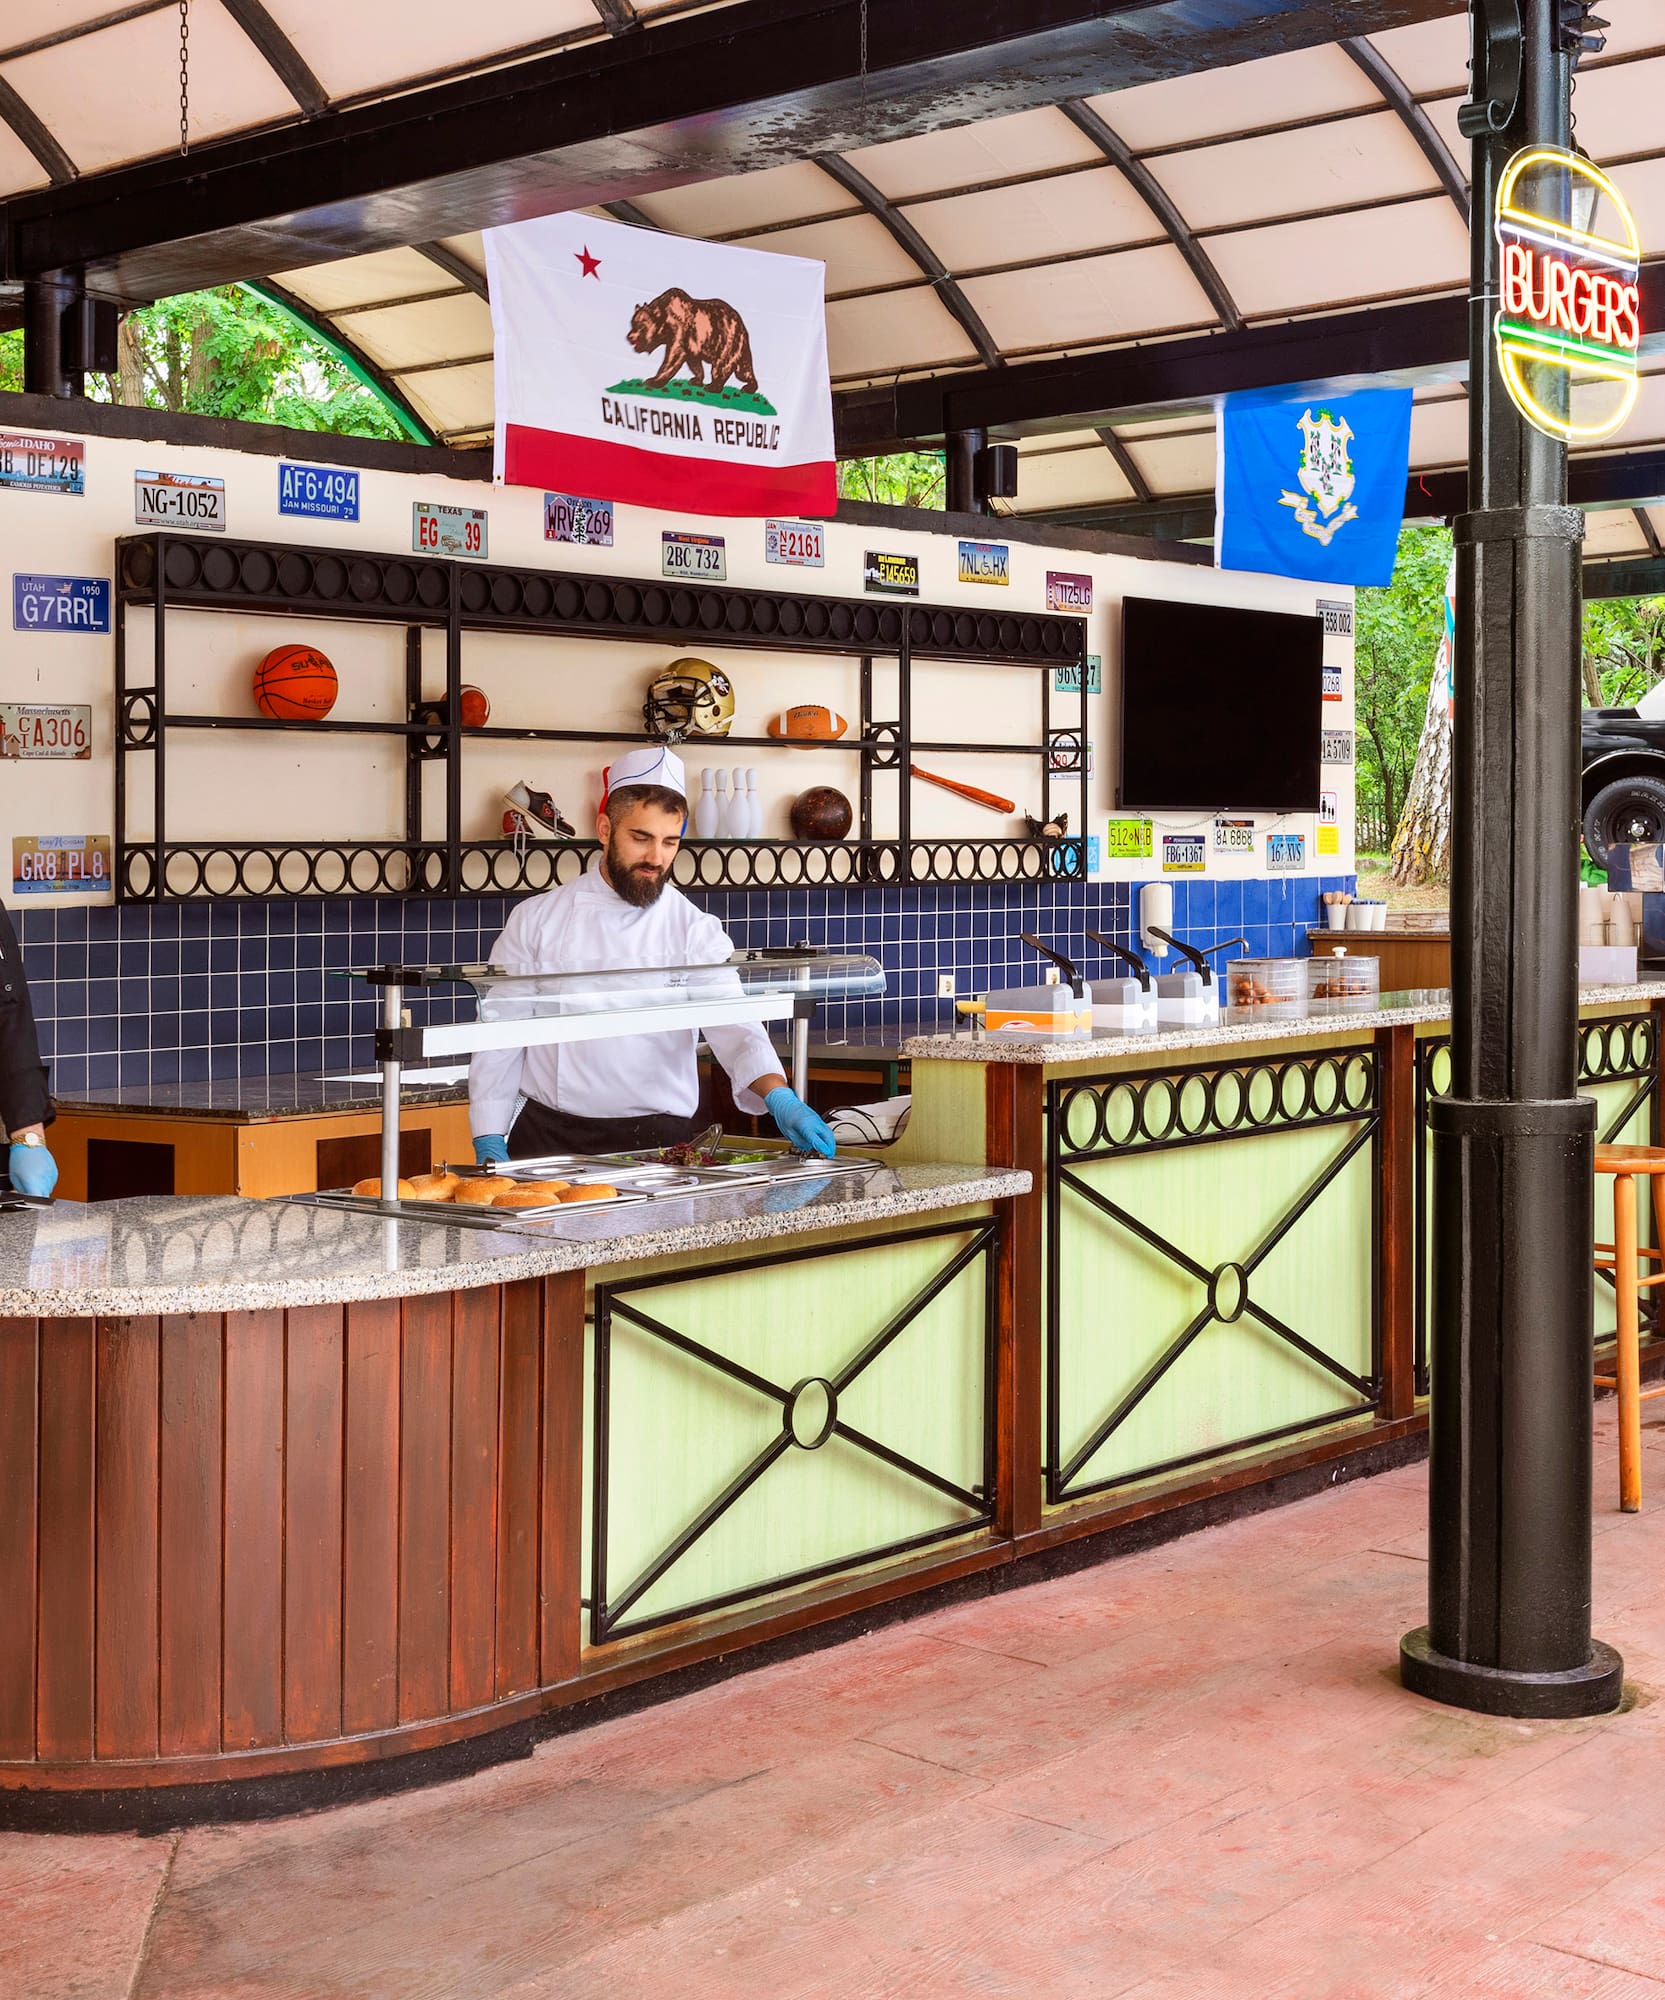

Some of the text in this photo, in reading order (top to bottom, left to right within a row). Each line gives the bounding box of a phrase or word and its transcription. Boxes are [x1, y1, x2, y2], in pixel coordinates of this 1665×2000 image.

[1504, 244, 1638, 349] BURGERS
[601, 397, 780, 450] CALIFORNIA REPUBLIC
[20, 438, 56, 451] IDAHO
[27, 451, 79, 481] DE129
[142, 487, 218, 519] NG-1052
[282, 499, 300, 509] JAN
[301, 501, 340, 514] MISSOURI
[438, 505, 463, 516] TEXAS
[419, 516, 438, 547] EG
[465, 521, 481, 552] 39
[547, 504, 611, 535] WRV 269
[666, 545, 720, 570] 2BC 732
[788, 532, 821, 559] 2161
[961, 552, 1007, 578] 7NL HX
[21, 582, 101, 597] UTAH 1950
[22, 594, 104, 626] G7RRL
[33, 717, 85, 748] A306
[1110, 827, 1128, 846] 512
[21, 851, 103, 881] GR8 PL8
